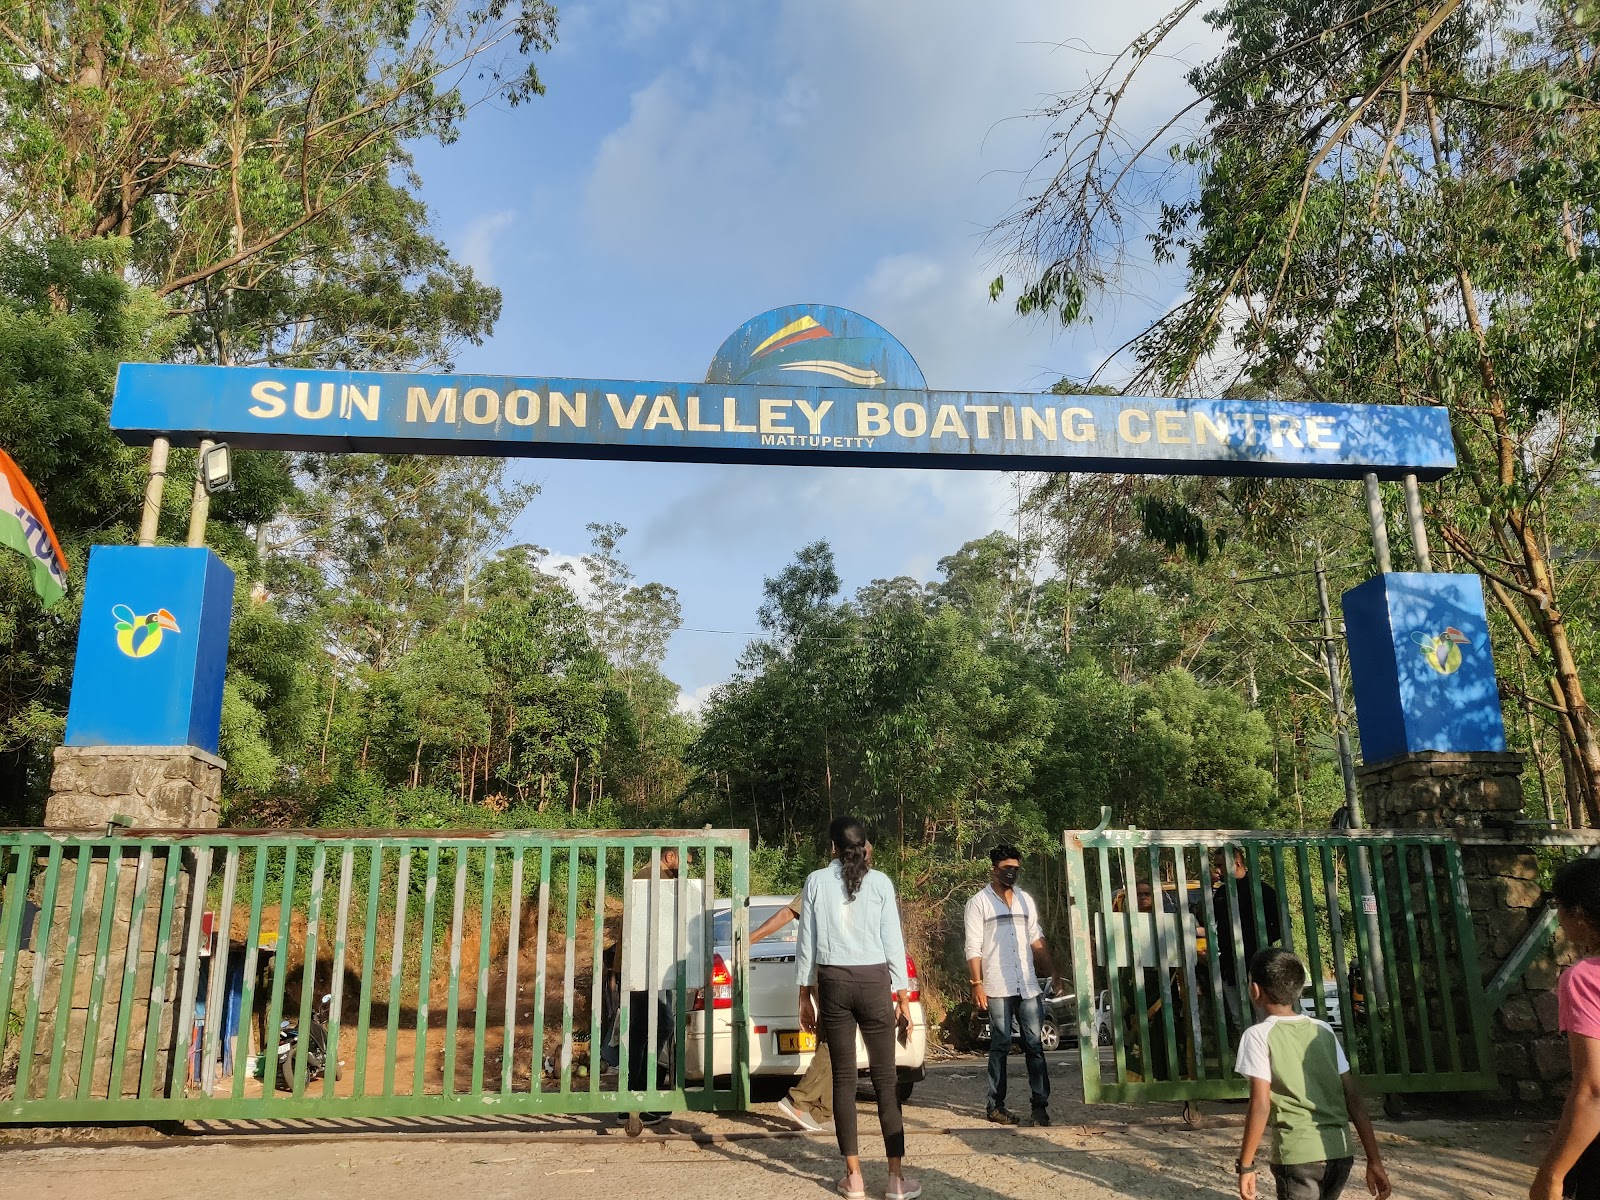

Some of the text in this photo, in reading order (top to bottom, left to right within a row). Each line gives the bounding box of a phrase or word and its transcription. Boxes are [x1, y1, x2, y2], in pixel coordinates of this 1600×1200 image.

[248, 380, 1341, 449] SUN MOON VALLEY BOATING CENTRE
[761, 434, 876, 448] MATTUPETTY
